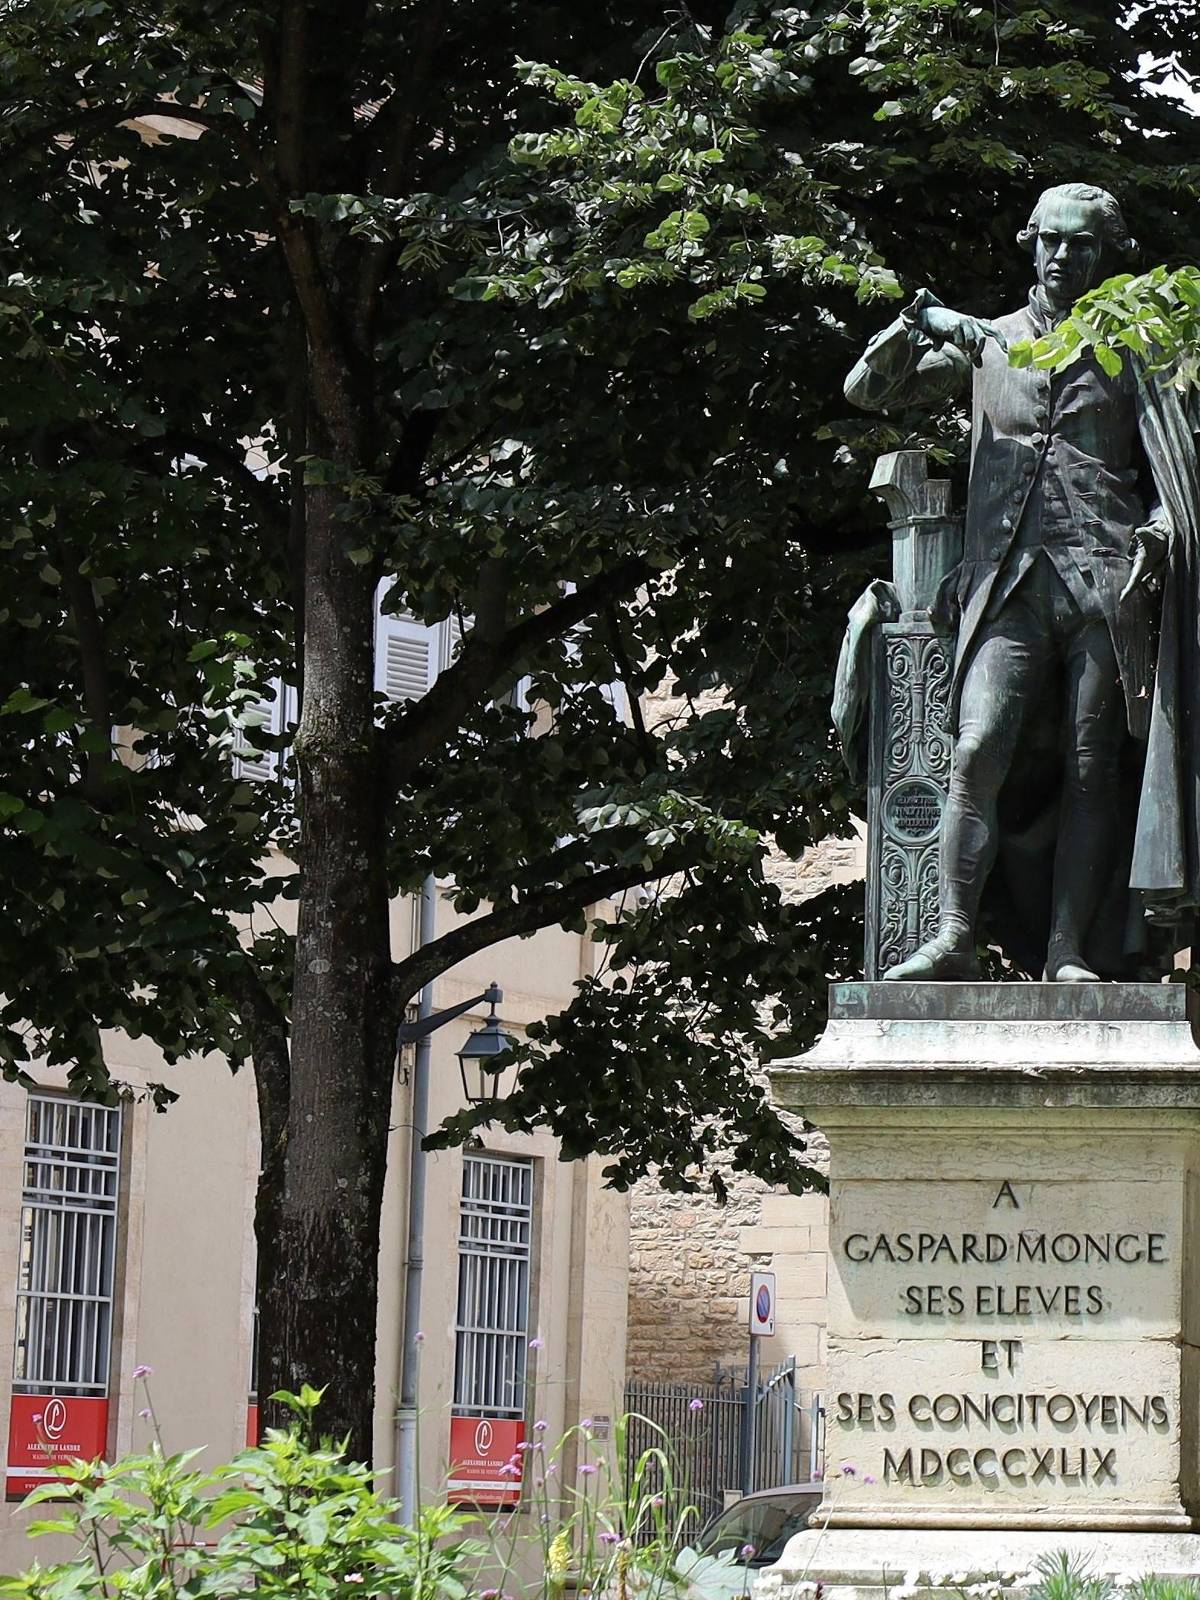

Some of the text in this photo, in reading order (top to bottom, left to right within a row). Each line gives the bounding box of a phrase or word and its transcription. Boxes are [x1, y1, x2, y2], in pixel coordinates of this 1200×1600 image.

[991, 1180, 1019, 1208] A
[844, 1233, 1168, 1263] GASPARD MONGE
[905, 1286, 1103, 1315] SES ELEVES
[981, 1340, 1023, 1369] ET
[837, 1393, 1168, 1425] SES CONCITOYENS
[883, 1447, 1117, 1478] MDCCCXLIX
